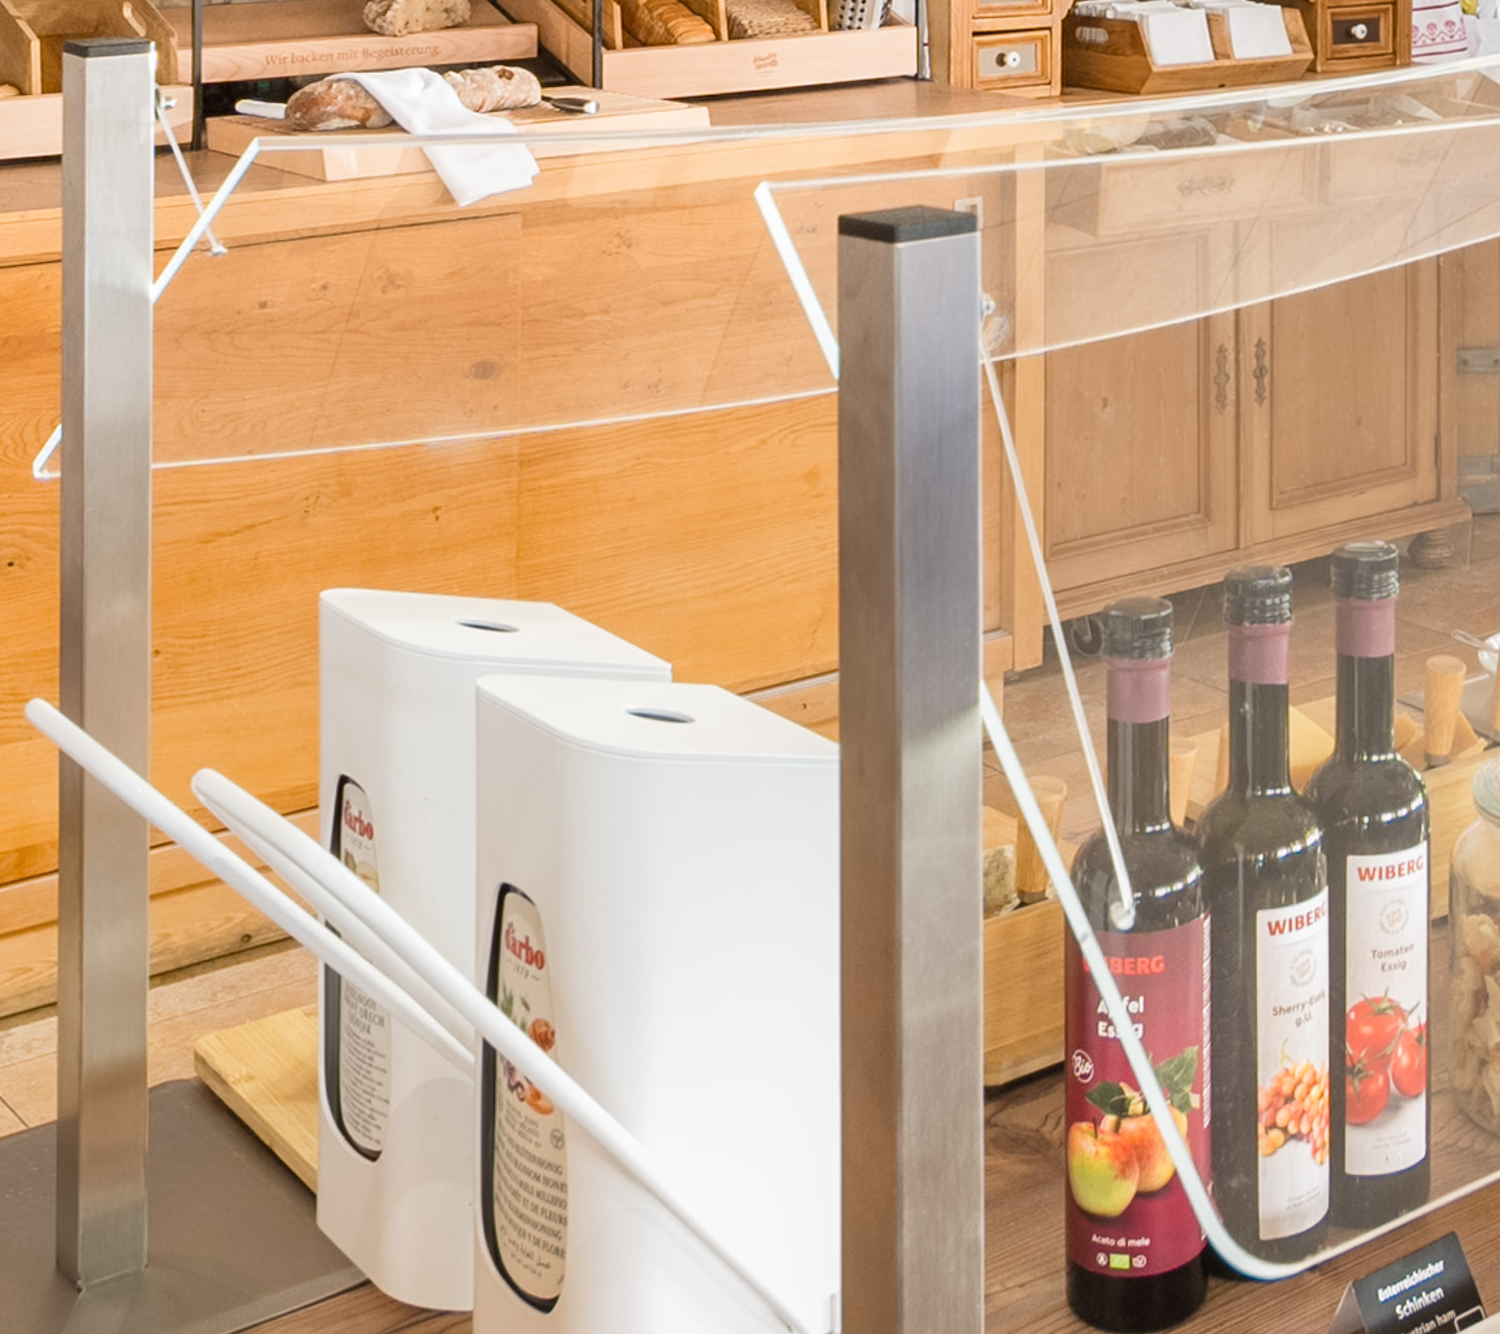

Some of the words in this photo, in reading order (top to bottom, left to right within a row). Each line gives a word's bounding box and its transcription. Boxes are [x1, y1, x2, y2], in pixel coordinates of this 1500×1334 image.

[265, 54, 287, 65] Wir
[290, 51, 334, 65] backen
[1357, 855, 1424, 882] WIBERG
[1370, 943, 1415, 960] Tomaten
[1082, 954, 1167, 977] BERG
[1380, 959, 1407, 973] Essig
[1097, 995, 1145, 1018] Afel
[1097, 1020, 1145, 1040] Esg
[1091, 1233, 1115, 1247] Aceto
[1116, 1234, 1127, 1247] di
[1127, 1235, 1151, 1248] mele
[1394, 1286, 1445, 1321] Schinken
[1435, 1309, 1457, 1326] ham
